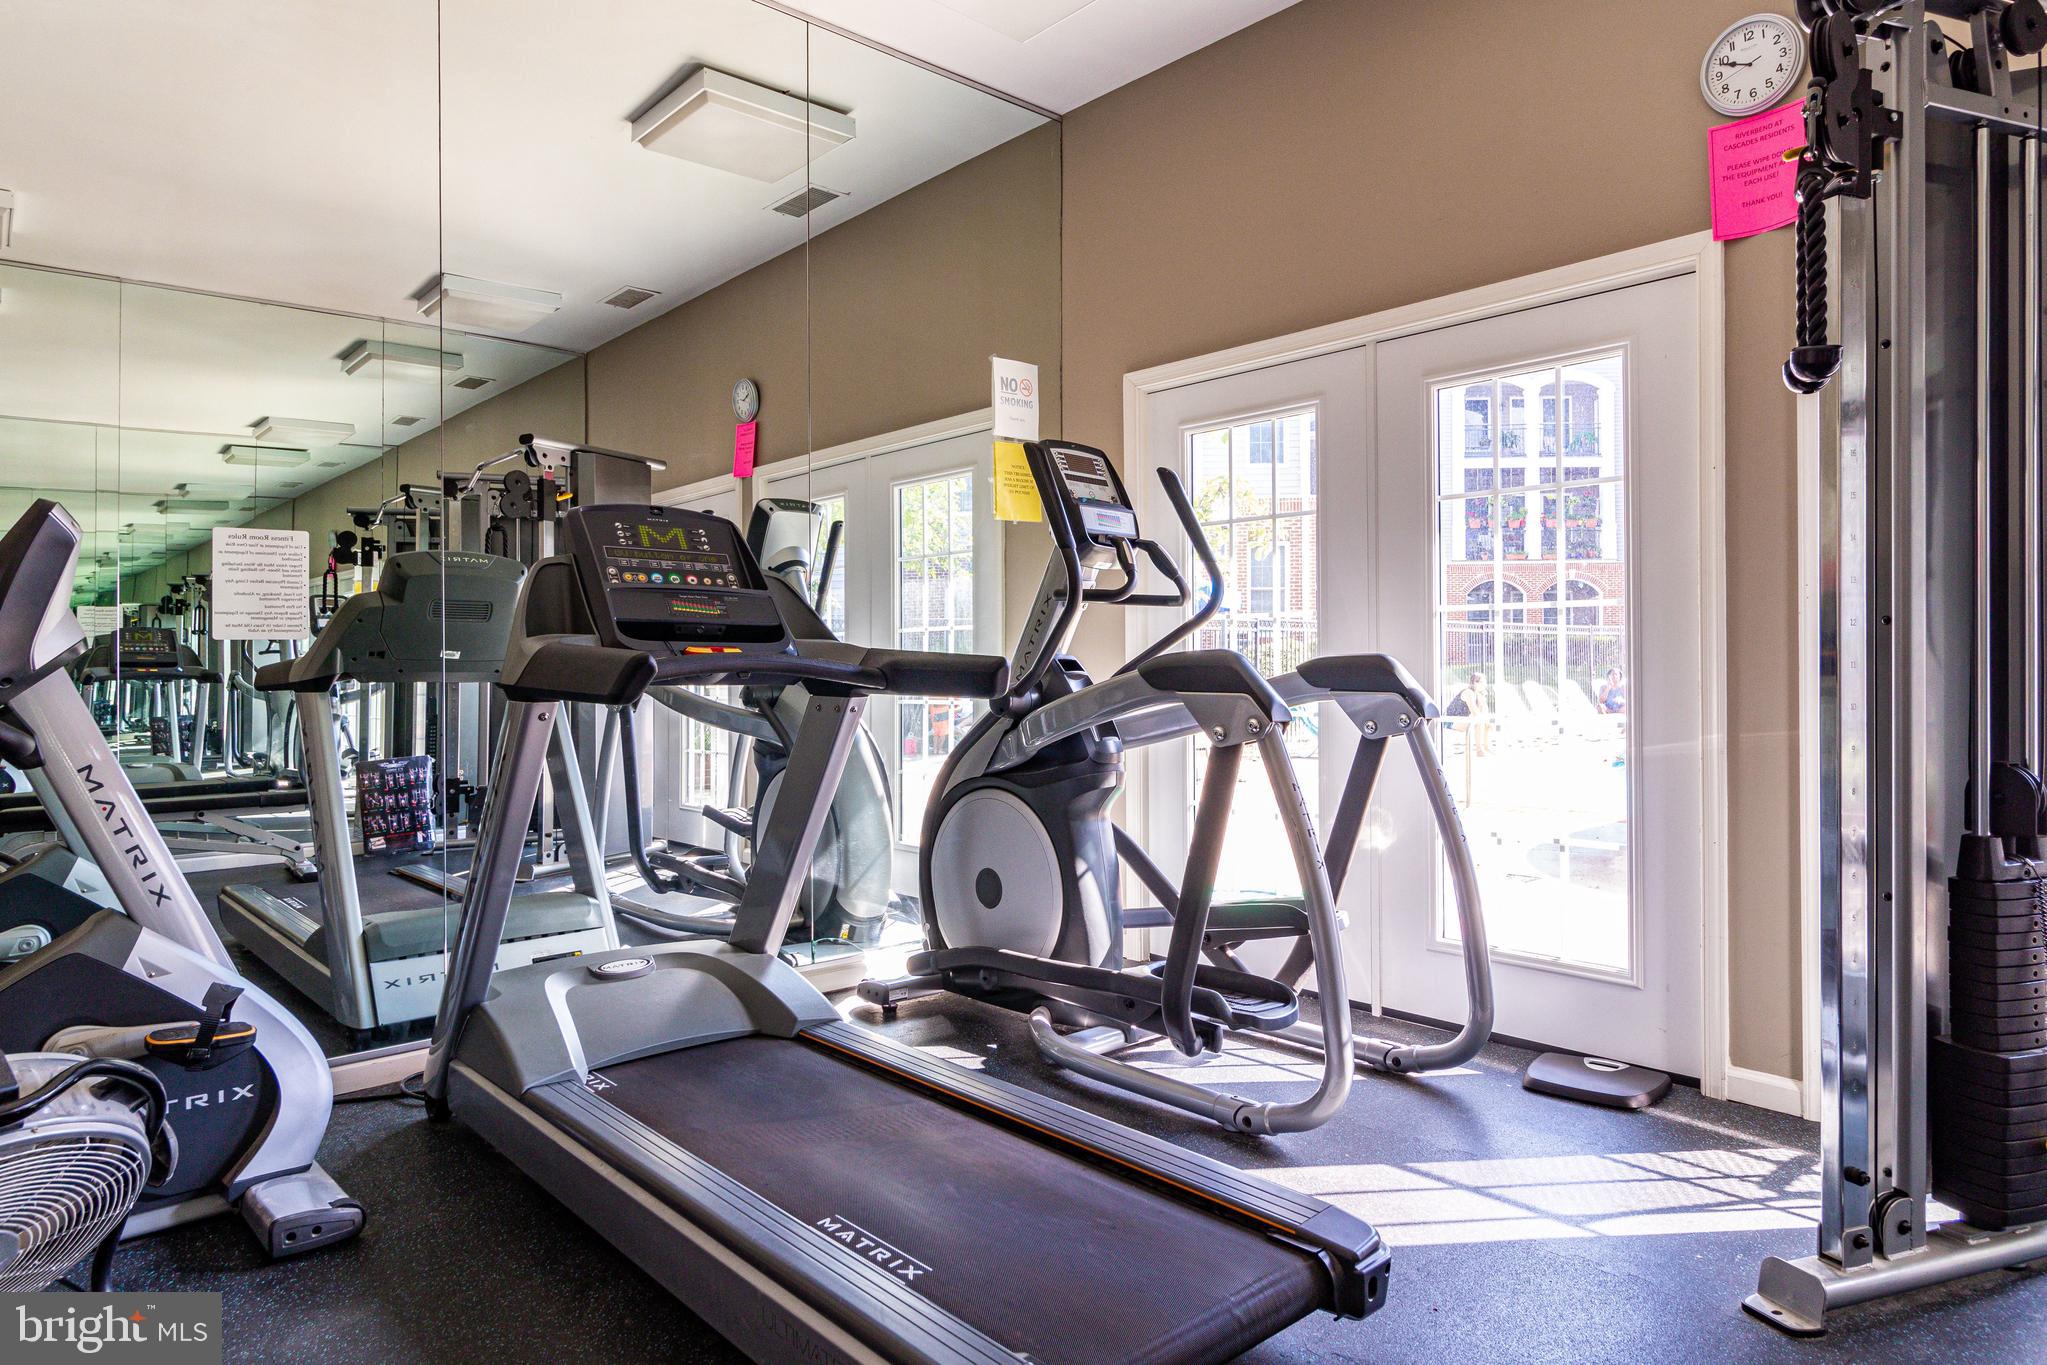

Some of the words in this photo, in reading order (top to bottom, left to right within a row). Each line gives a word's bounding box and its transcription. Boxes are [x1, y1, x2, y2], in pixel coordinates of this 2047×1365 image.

[1743, 30, 1754, 42] 12
[1773, 34, 1781, 45] 2
[1729, 41, 1735, 52] 11
[1779, 47, 1787, 58] 3
[1719, 55, 1729, 66] 10
[1775, 63, 1784, 73] 4
[1715, 71, 1723, 81] 9
[1721, 84, 1729, 93] 8
[1765, 78, 1774, 88] 5
[1734, 89, 1741, 100] 7
[1749, 88, 1757, 98] 6
[1735, 122, 1773, 140] RIVERBEND
[1774, 119, 1783, 127] AT
[1723, 136, 1758, 152] CASCADES
[1760, 124, 1796, 142] RESIDENTS
[1726, 160, 1751, 172] PLEASE
[1753, 155, 1770, 165] WIPE
[1771, 147, 1794, 159] DO
[1722, 172, 1736, 182] THE
[1737, 162, 1777, 179] EQUIPMENT
[1744, 176, 1762, 187] EACH
[1742, 197, 1765, 208] THANK
[1000, 376, 1018, 393] NO
[1000, 396, 1033, 409] SMOKING
[1850, 619, 1857, 627] 12
[77, 764, 172, 908] MATRIX
[586, 1074, 610, 1091] RIX
[165, 1083, 254, 1114] TRIX
[817, 1217, 924, 1281] MATRIX
